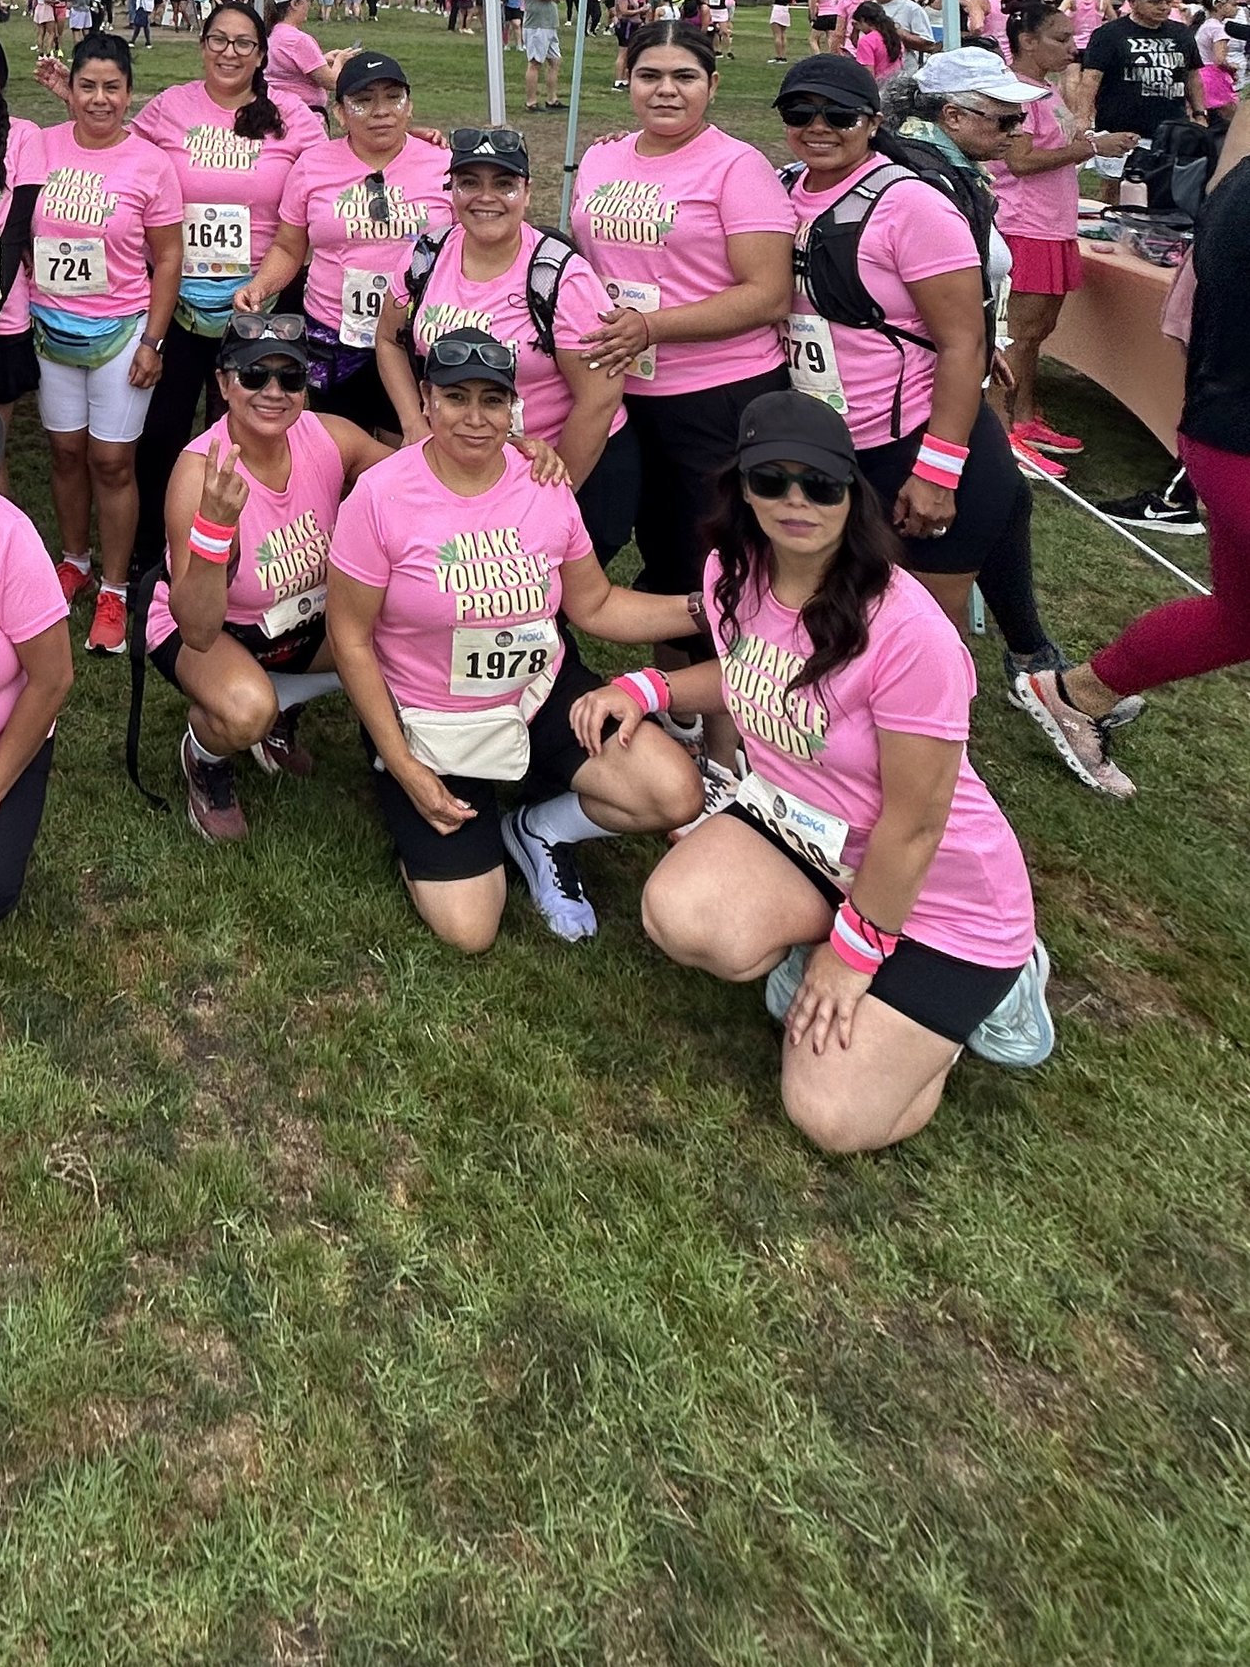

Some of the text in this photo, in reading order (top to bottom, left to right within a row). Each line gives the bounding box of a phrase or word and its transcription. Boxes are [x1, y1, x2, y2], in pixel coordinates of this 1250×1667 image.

[1148, 52, 1186, 69] YOUR
[1124, 66, 1174, 85] LIMITS
[1141, 81, 1186, 100] BEHIND
[57, 166, 107, 189] MAKE
[607, 179, 665, 201] MAKE
[352, 184, 405, 203] MKE
[332, 201, 430, 221] YOUSELF
[582, 194, 680, 224] YOURSELF
[187, 223, 243, 249] 1643
[48, 257, 92, 281] 724
[351, 290, 386, 318] 19
[621, 288, 646, 301] HOKA
[437, 302, 495, 332] MAKE
[266, 508, 322, 558] MAKE
[454, 527, 525, 562] MAKE
[433, 552, 552, 594] YOURSELF
[465, 648, 548, 680] 1978
[720, 655, 829, 738] YOURSELF
[790, 809, 827, 835] HOKA
